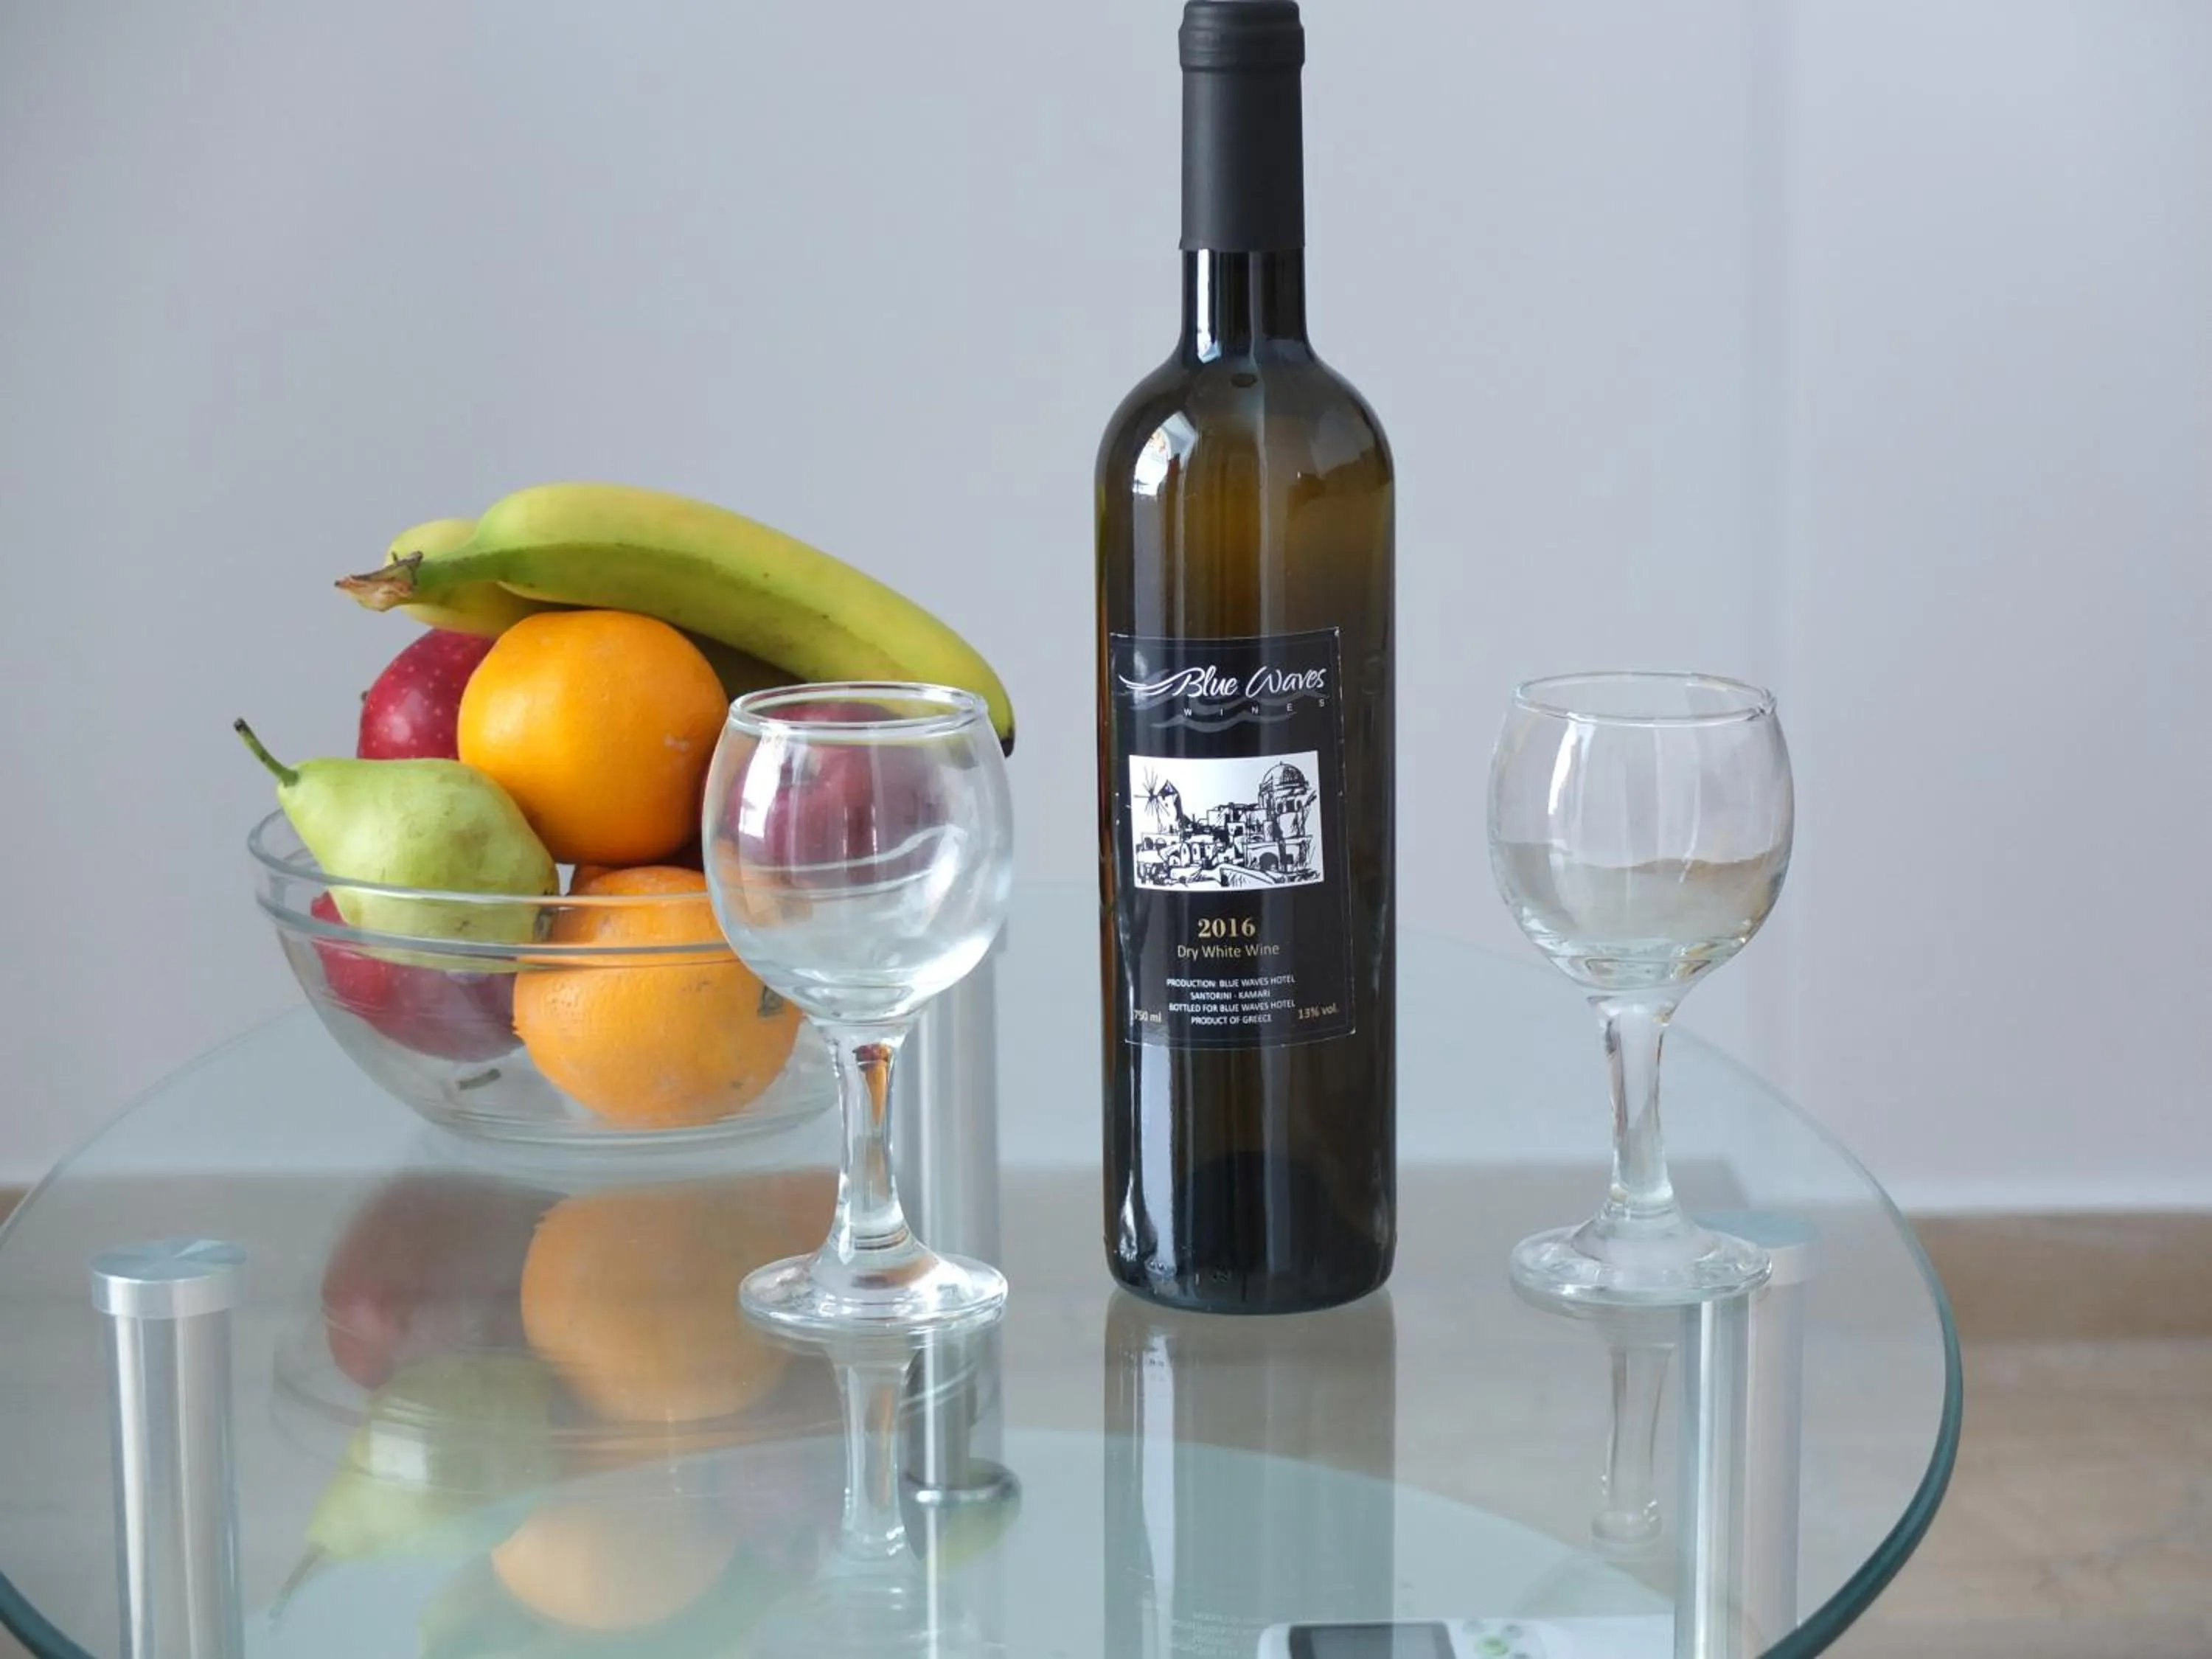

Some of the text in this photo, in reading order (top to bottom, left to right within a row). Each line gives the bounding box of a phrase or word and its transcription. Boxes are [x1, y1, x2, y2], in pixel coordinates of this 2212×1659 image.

[1172, 664, 1326, 698] Blue Waves
[1197, 918, 1256, 938] 2016
[1178, 943, 1280, 961] Dry White Wine
[1219, 978, 1239, 987] BLUE
[1241, 977, 1269, 986] WAVES
[1270, 975, 1295, 984] HOTEL
[1190, 992, 1232, 1001] SANTORINI
[1238, 990, 1270, 999] KAMARI
[1169, 999, 1295, 1012] BOTTLED FOR BLUE WAVES HOTEL
[1133, 1009, 1162, 1023] 750 ml
[1298, 1006, 1320, 1019] 13%
[1191, 1014, 1272, 1025] PRODUCT OF GREECE
